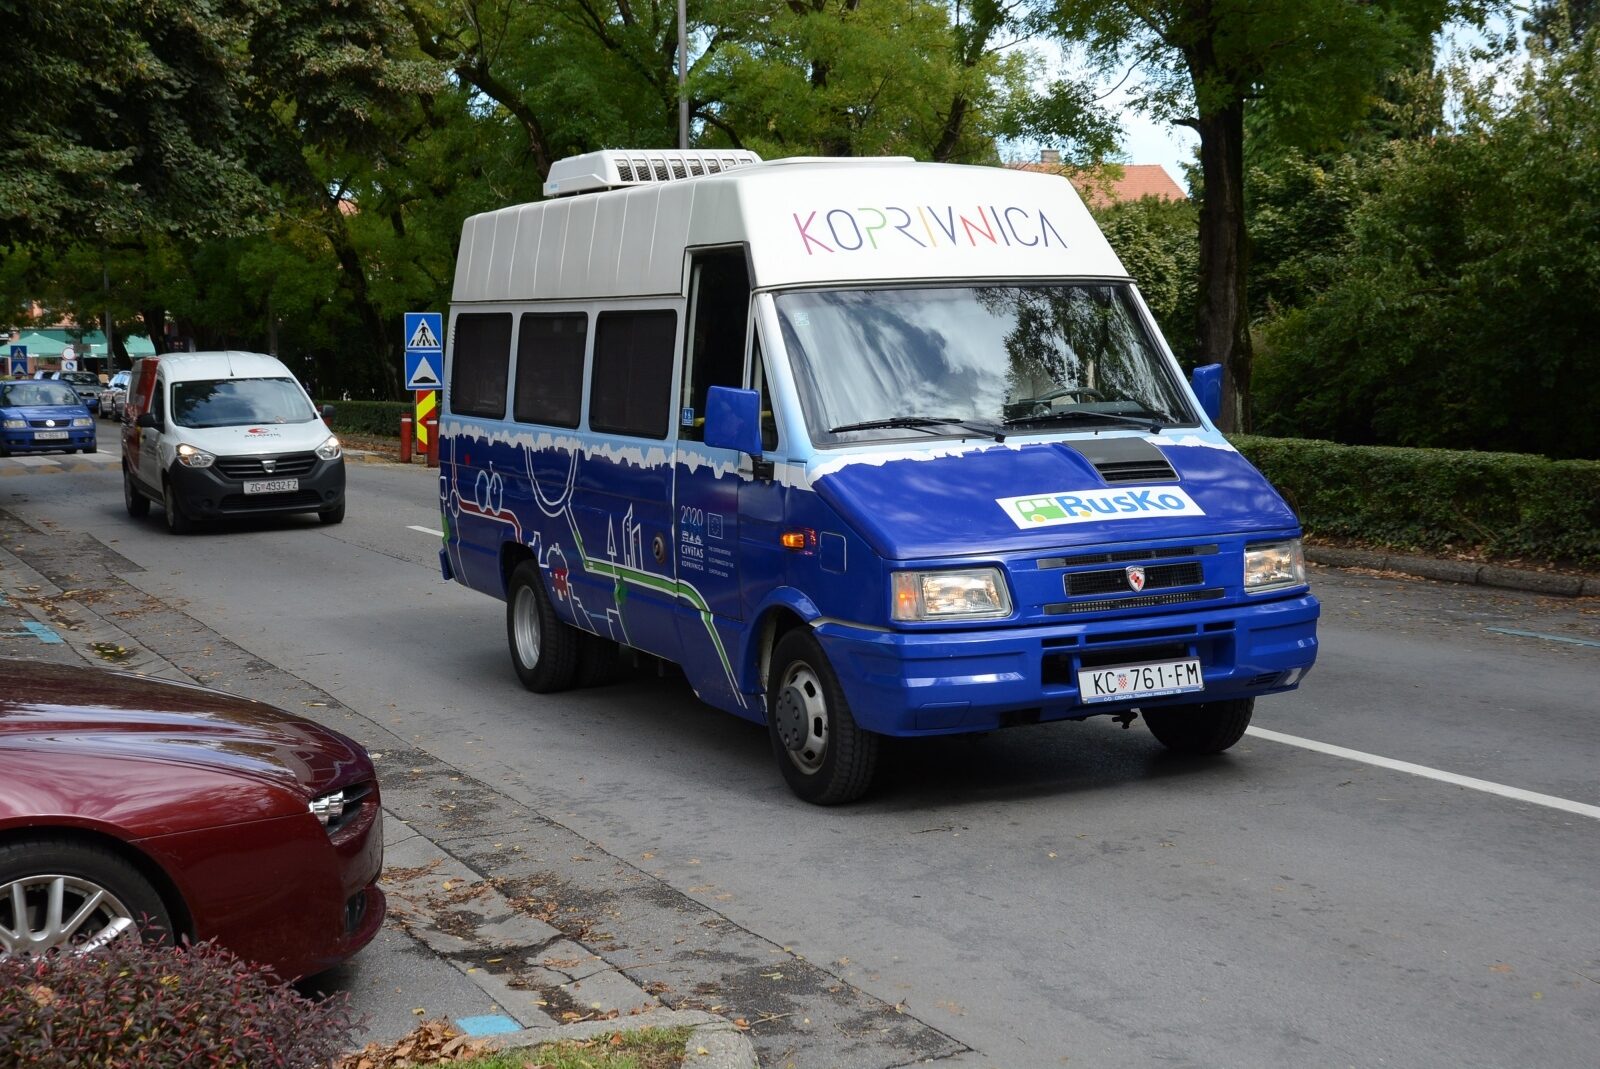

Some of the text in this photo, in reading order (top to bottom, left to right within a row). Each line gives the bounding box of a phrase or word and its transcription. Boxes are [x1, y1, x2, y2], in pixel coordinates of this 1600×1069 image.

[793, 205, 1068, 255] KOPRIVNICA
[250, 483, 261, 492] ZG
[681, 505, 703, 527] 2020
[1093, 663, 1199, 694] KC 761-FM
